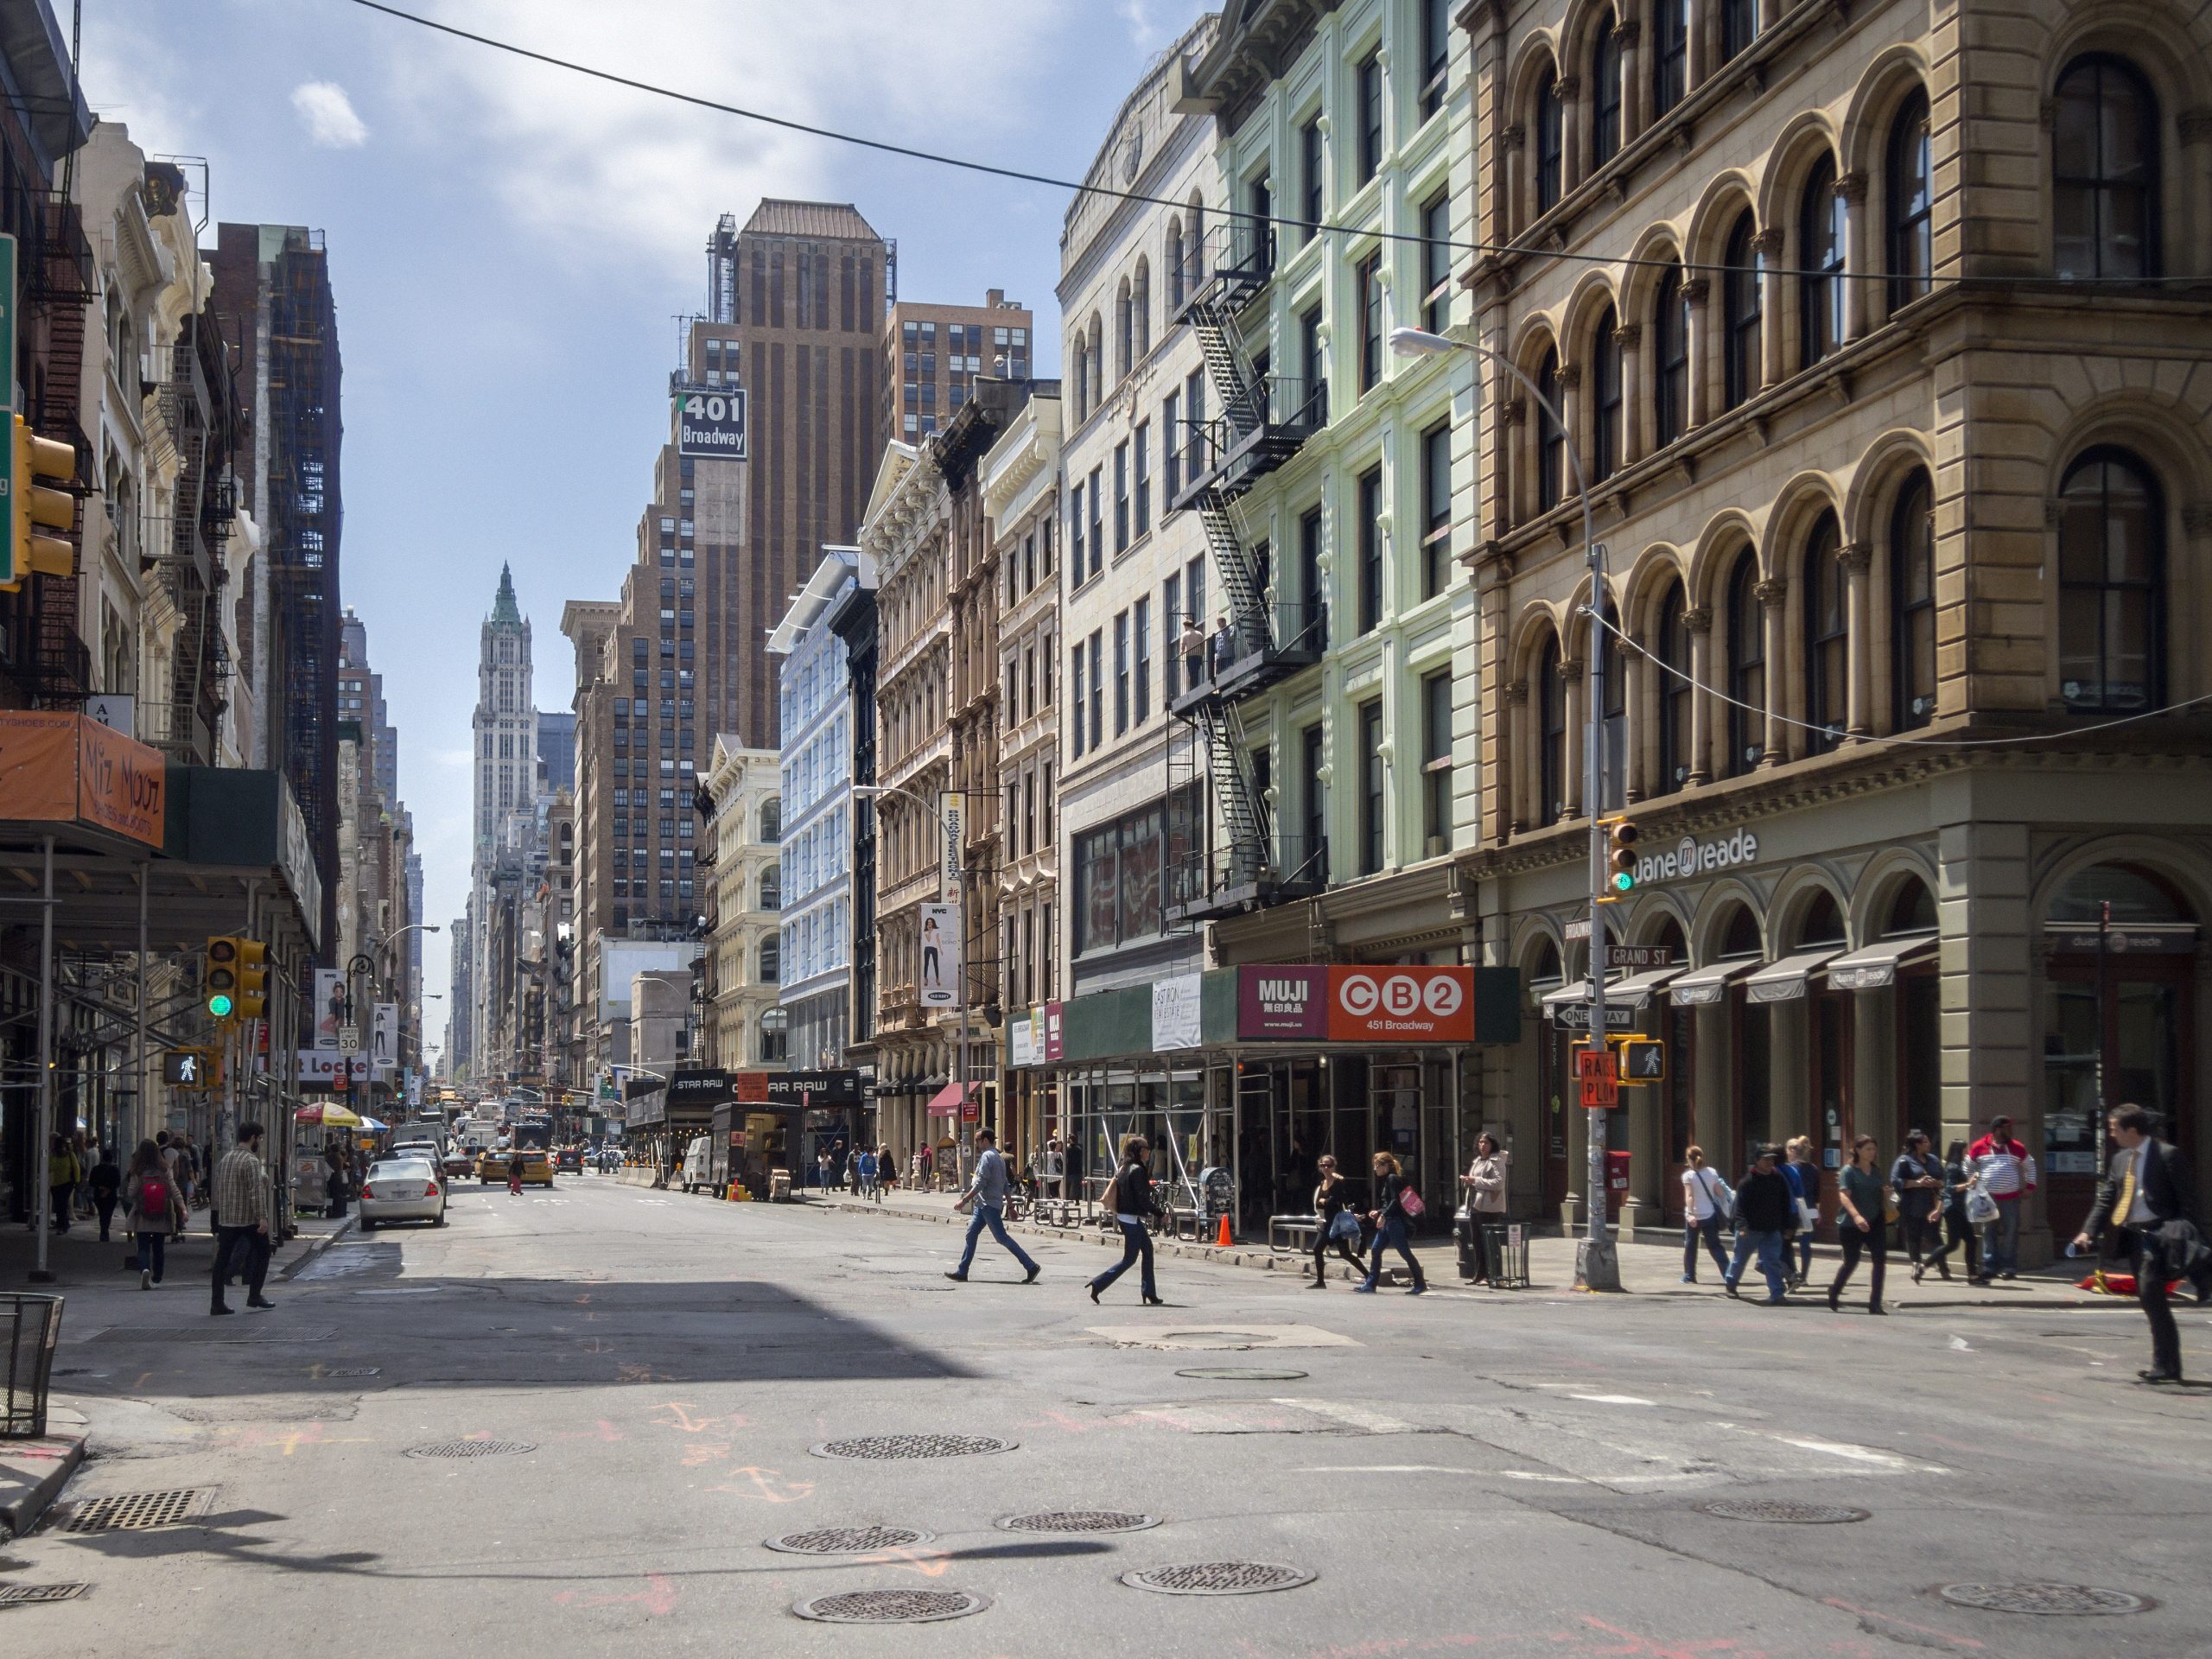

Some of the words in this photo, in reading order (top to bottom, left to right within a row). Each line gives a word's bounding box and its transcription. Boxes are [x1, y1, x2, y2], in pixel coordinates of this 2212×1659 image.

[685, 396, 740, 422] 401
[683, 425, 744, 450] Broadway
[1633, 851, 1677, 884] uane
[1697, 827, 1758, 872] reade
[1566, 921, 1591, 939] BROADWAY
[1612, 949, 1649, 965] GRAND
[1653, 950, 1667, 965] ST
[1259, 980, 1308, 1001] MUJI
[1345, 981, 1453, 1010] CB2
[1263, 1002, 1303, 1014] 無印良品
[1566, 1010, 1589, 1021] ONE
[1367, 1020, 1382, 1030] 451
[1385, 1020, 1434, 1032] Broadway
[341, 1039, 358, 1049] 30
[1584, 1058, 1616, 1077] RAISE
[702, 1079, 723, 1089] RAW
[793, 1081, 827, 1091] RAW
